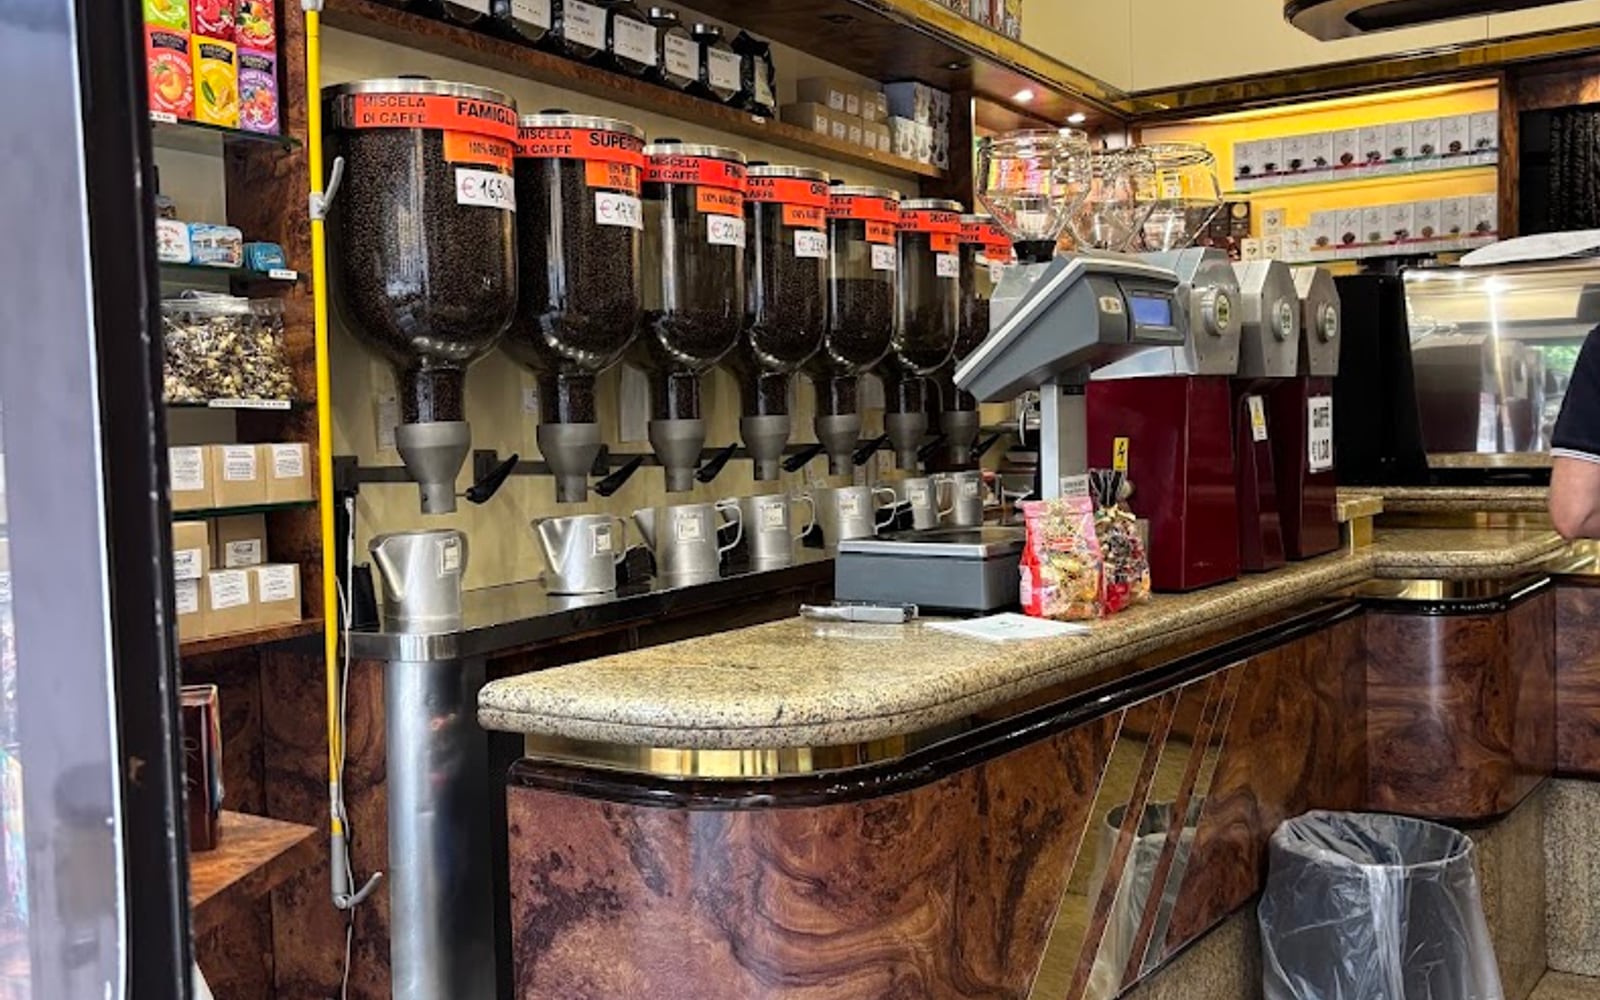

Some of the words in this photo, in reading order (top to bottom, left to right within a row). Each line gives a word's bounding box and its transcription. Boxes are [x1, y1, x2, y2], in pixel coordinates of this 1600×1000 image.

[363, 95, 426, 107] MISCELA
[363, 113, 375, 123] DI
[516, 145, 527, 154] DI
[649, 155, 700, 168] MISCELA
[649, 170, 661, 178] DI
